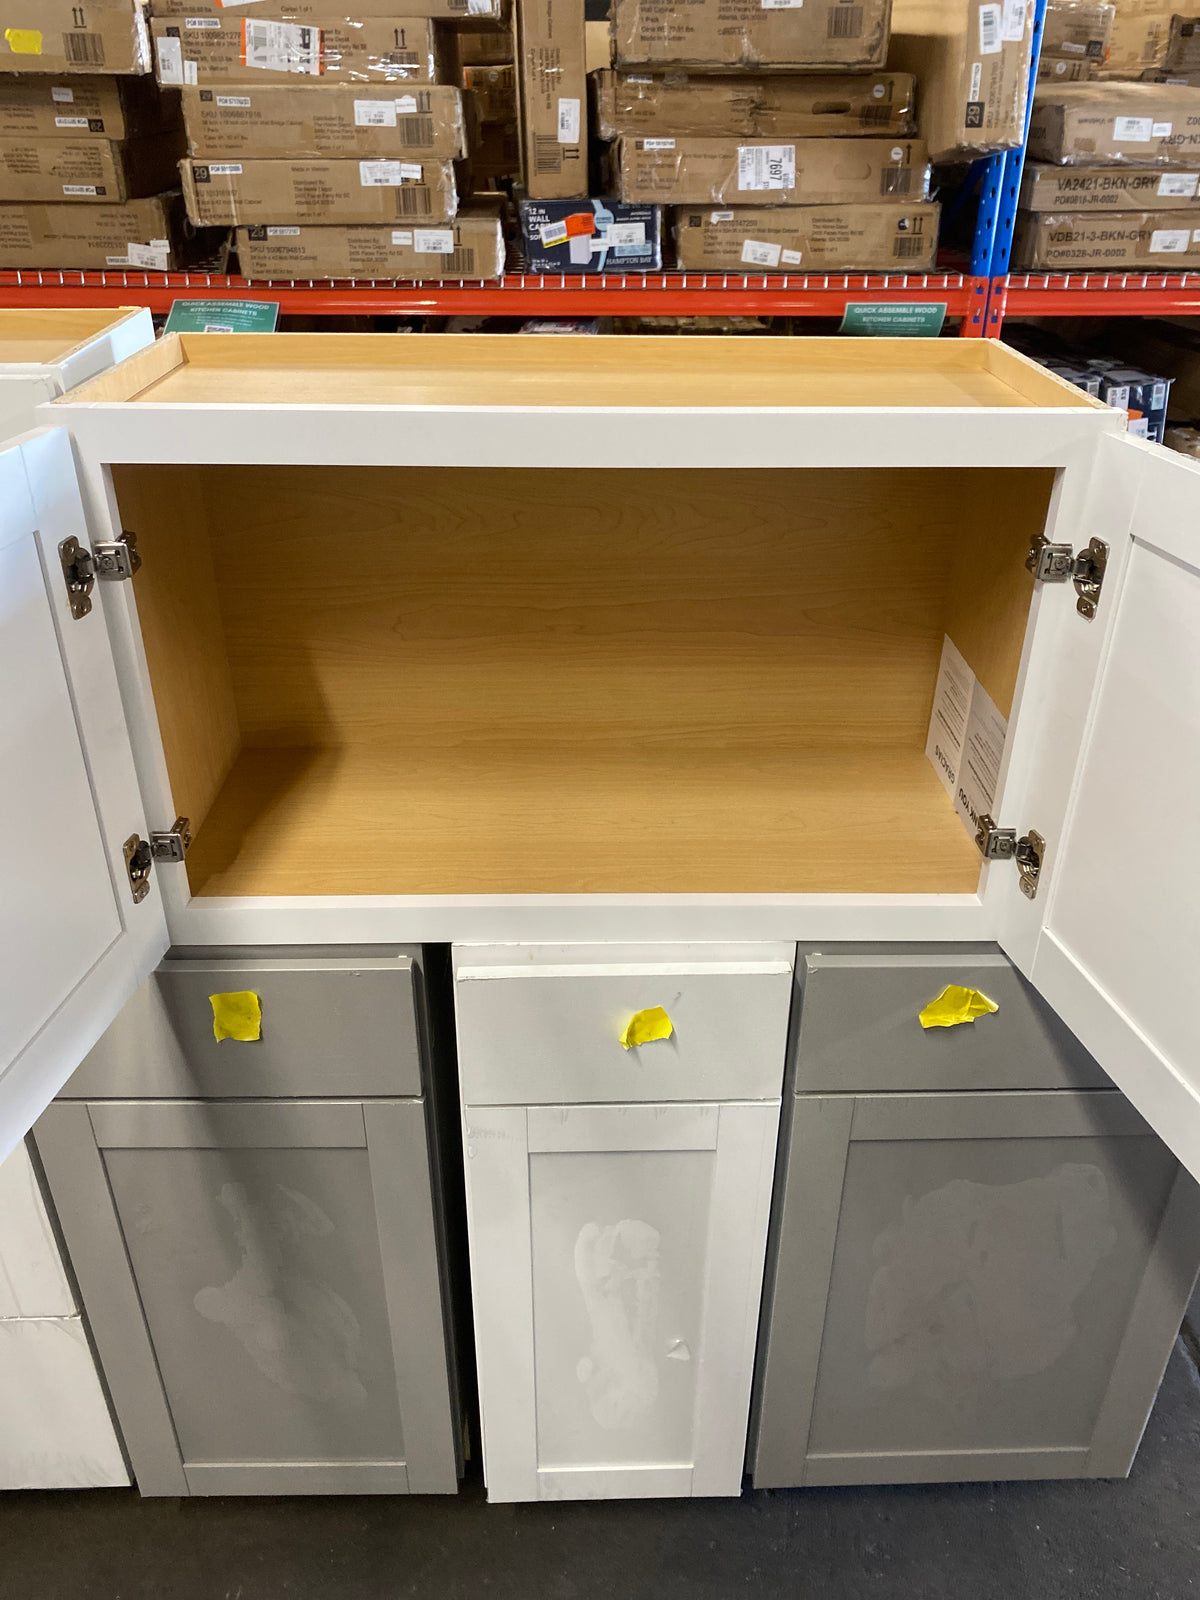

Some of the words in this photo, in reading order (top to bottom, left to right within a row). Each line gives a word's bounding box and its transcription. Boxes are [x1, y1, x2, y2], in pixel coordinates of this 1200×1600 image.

[967, 105, 980, 125] 29
[194, 168, 208, 179] 29
[770, 158, 783, 181] 7697
[1056, 177, 1159, 191] VA2421-BKN-GRY
[1049, 230, 1152, 242] VDB21-3-BKN-GRY
[222, 308, 258, 316] CABINETS
[935, 745, 955, 785] GRACIAS
